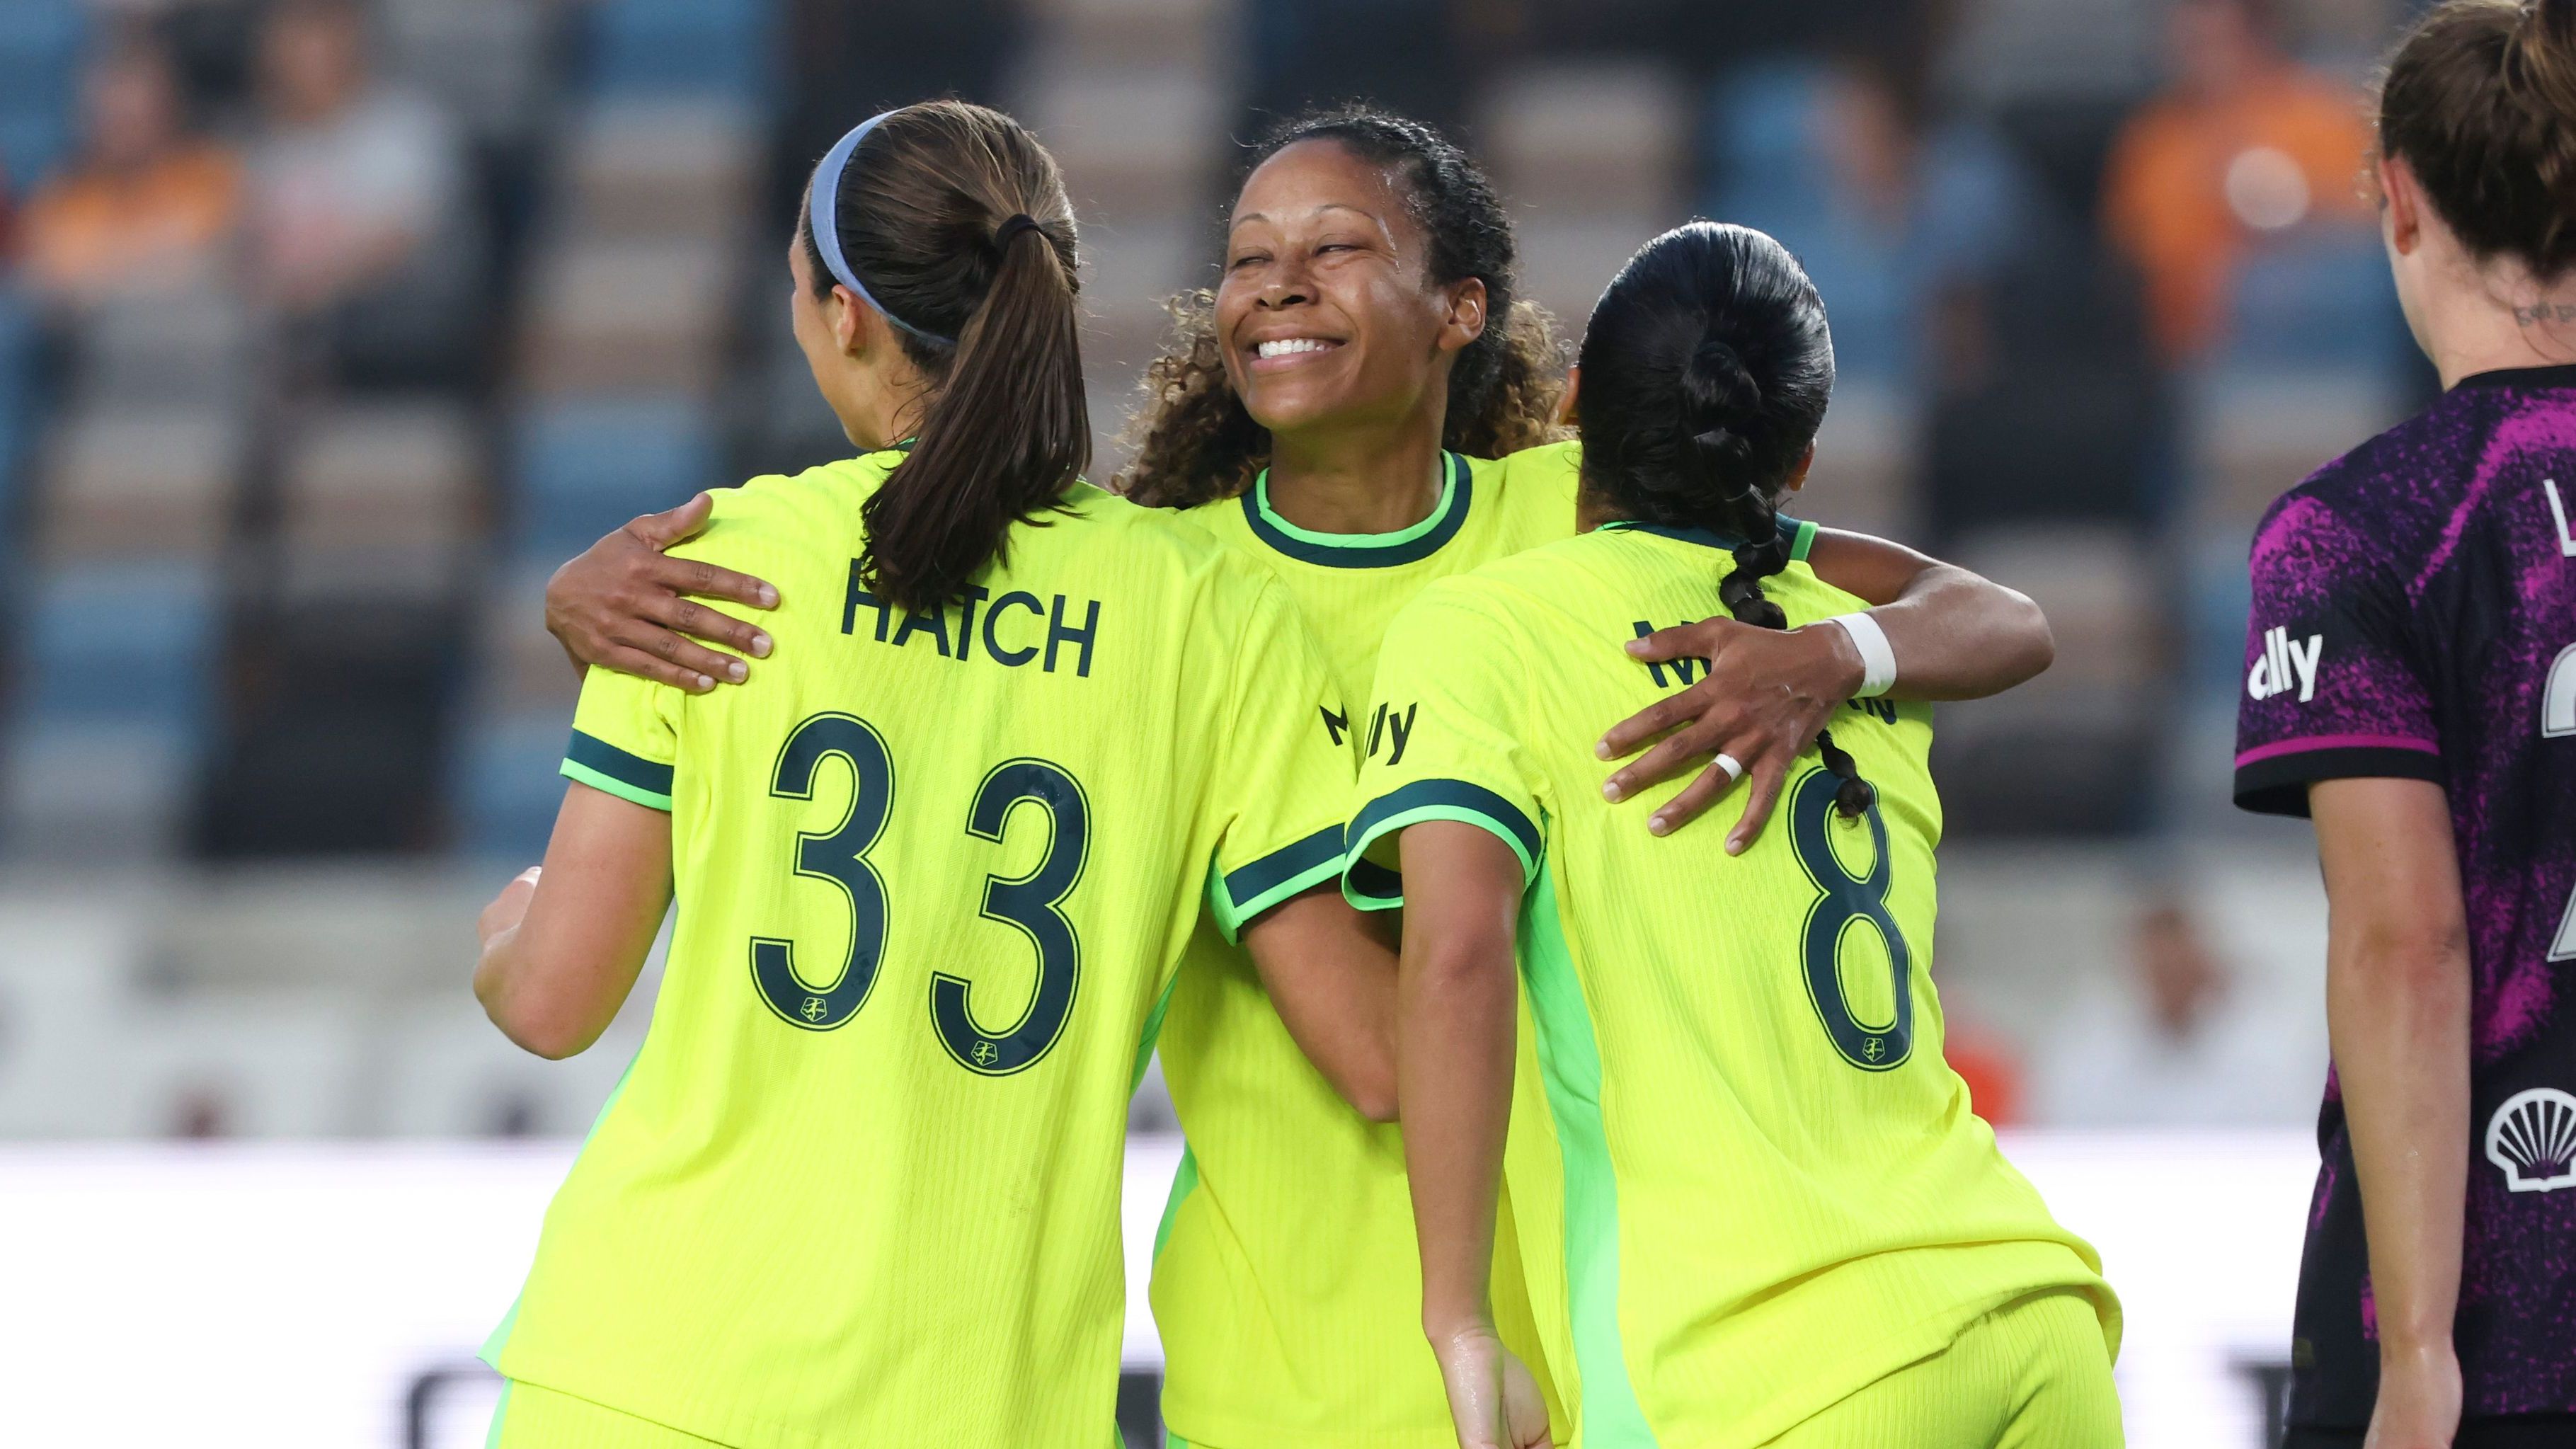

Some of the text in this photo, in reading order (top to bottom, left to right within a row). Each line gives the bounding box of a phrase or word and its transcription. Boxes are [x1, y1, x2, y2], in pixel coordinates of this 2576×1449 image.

[841, 558, 1101, 677] HATCH
[2248, 626, 2323, 703] ally
[749, 711, 1092, 1077] 33
[1789, 764, 1914, 1072] 8
